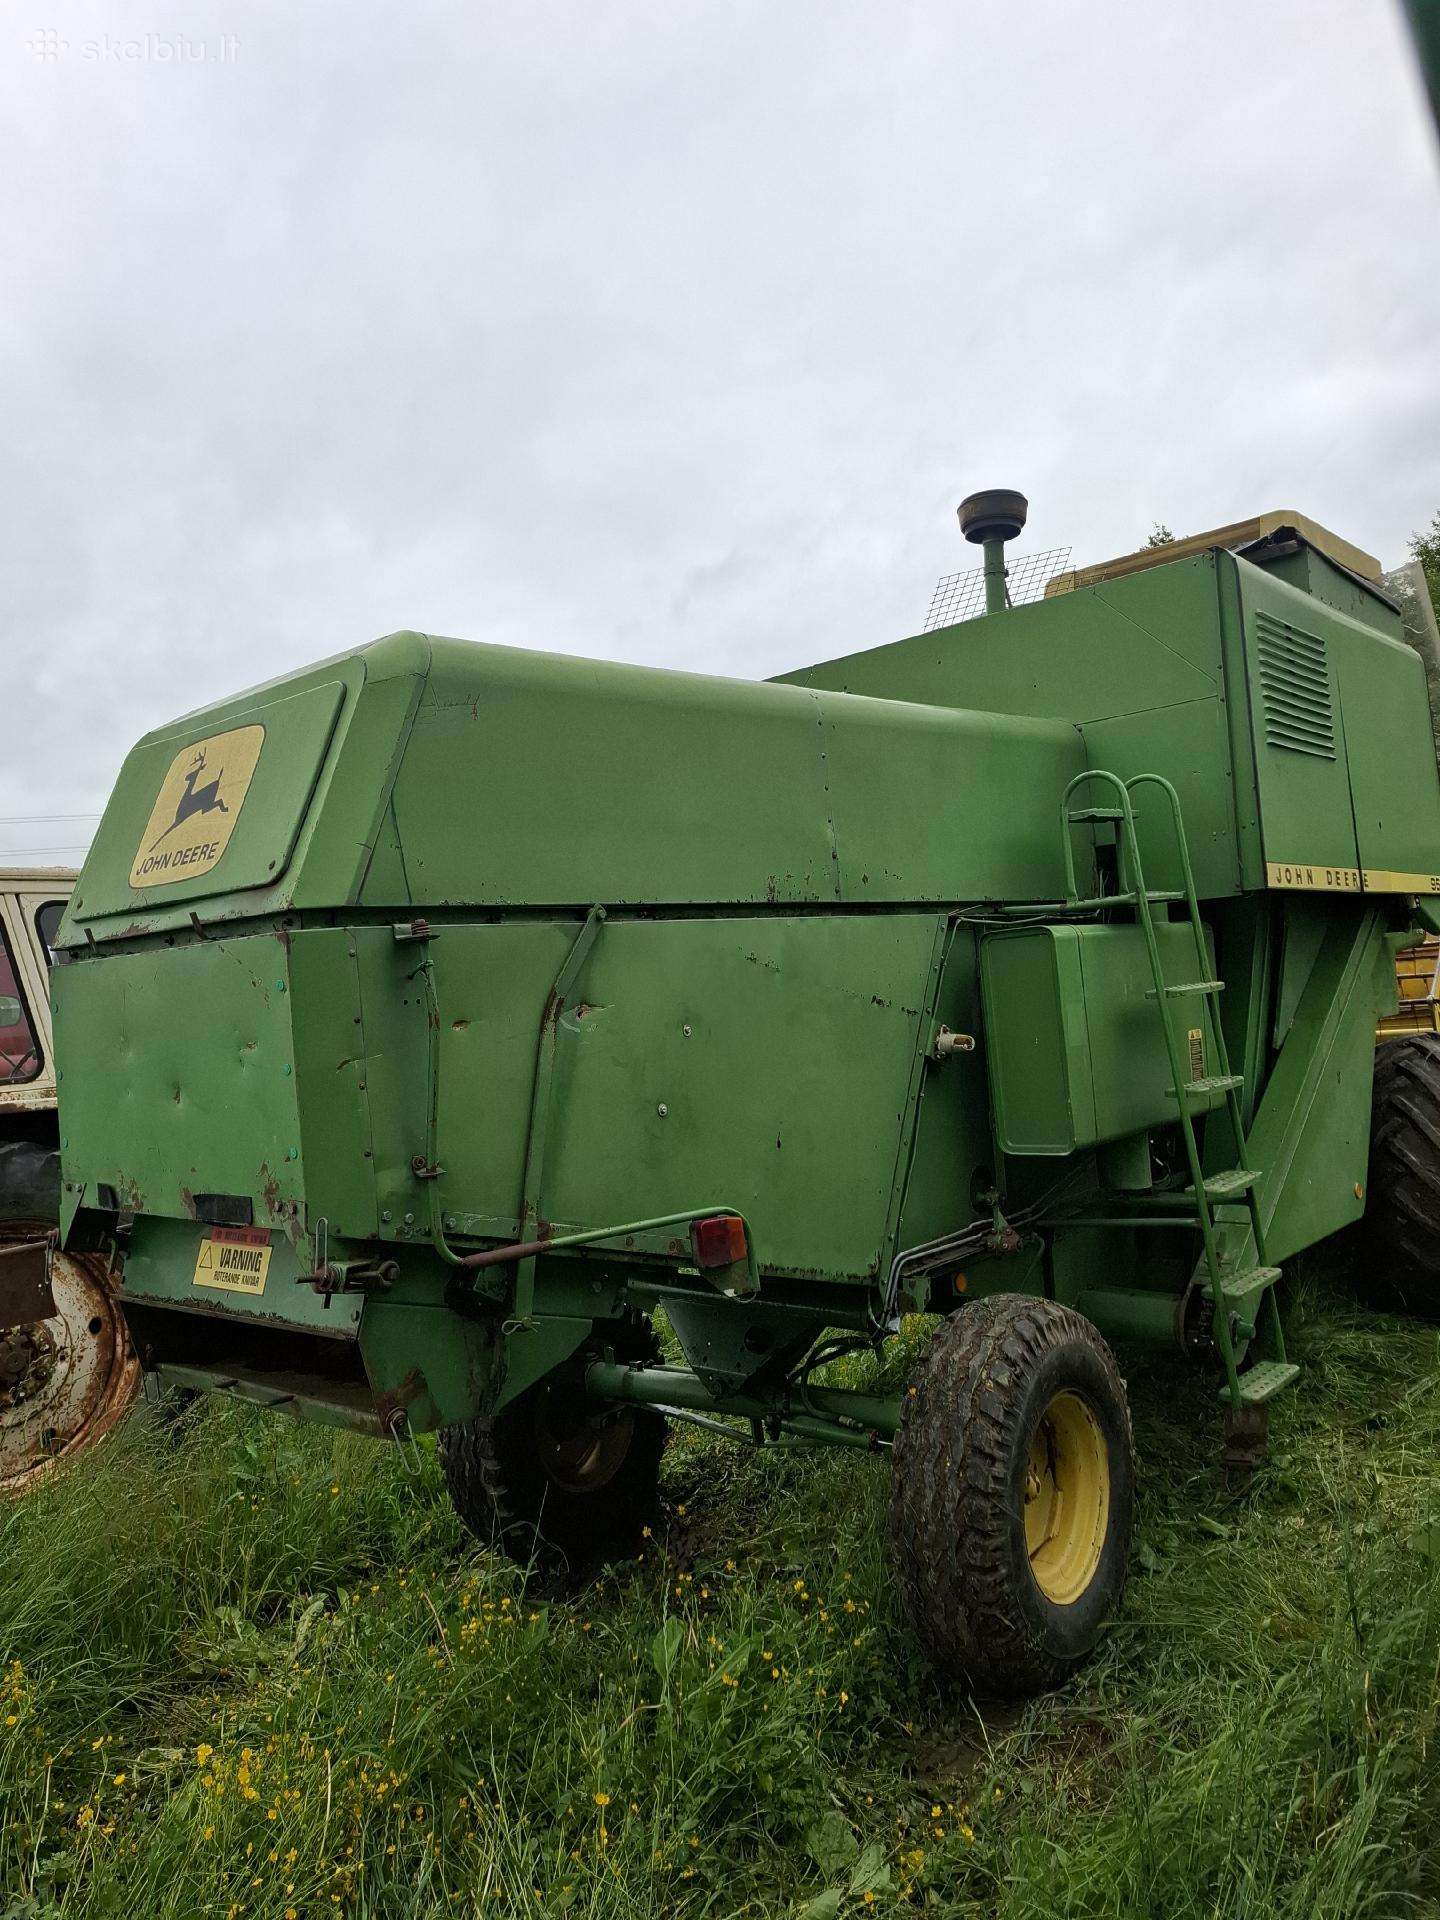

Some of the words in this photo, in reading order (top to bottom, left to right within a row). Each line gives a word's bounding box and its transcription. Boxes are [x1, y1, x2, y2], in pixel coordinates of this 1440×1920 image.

[136, 852, 173, 876] JOHN
[171, 841, 220, 868] DEERE
[1276, 867, 1314, 885] JOHN
[1326, 870, 1369, 888] DEERE
[220, 1247, 263, 1273] VARNING
